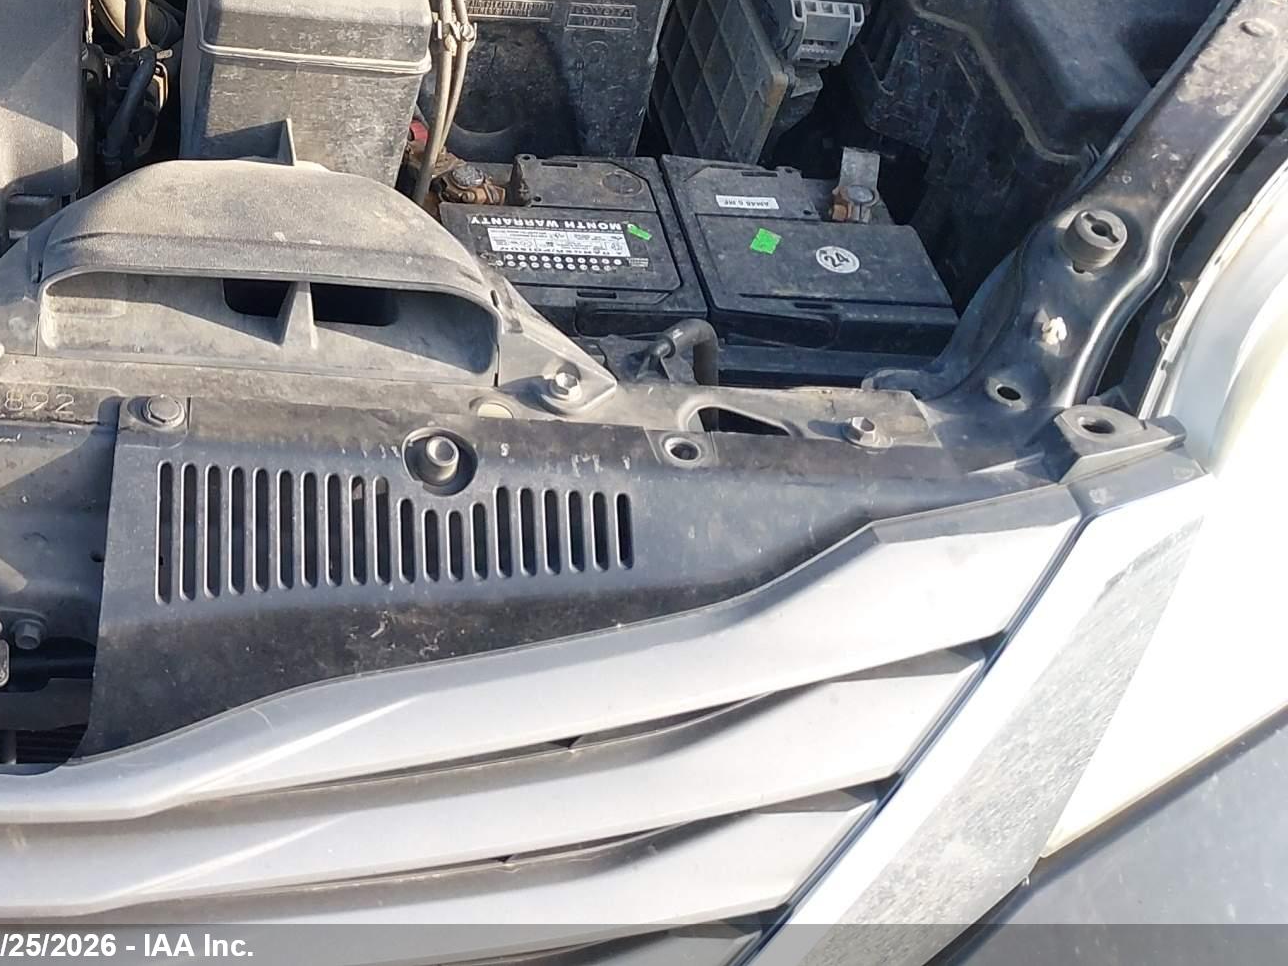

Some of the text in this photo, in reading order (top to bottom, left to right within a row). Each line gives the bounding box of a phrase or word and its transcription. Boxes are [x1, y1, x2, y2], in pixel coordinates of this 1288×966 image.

[570, 4, 632, 17] TOYOTA
[470, 216, 623, 232] MONTH WARRANTY
[824, 251, 851, 268] 24
